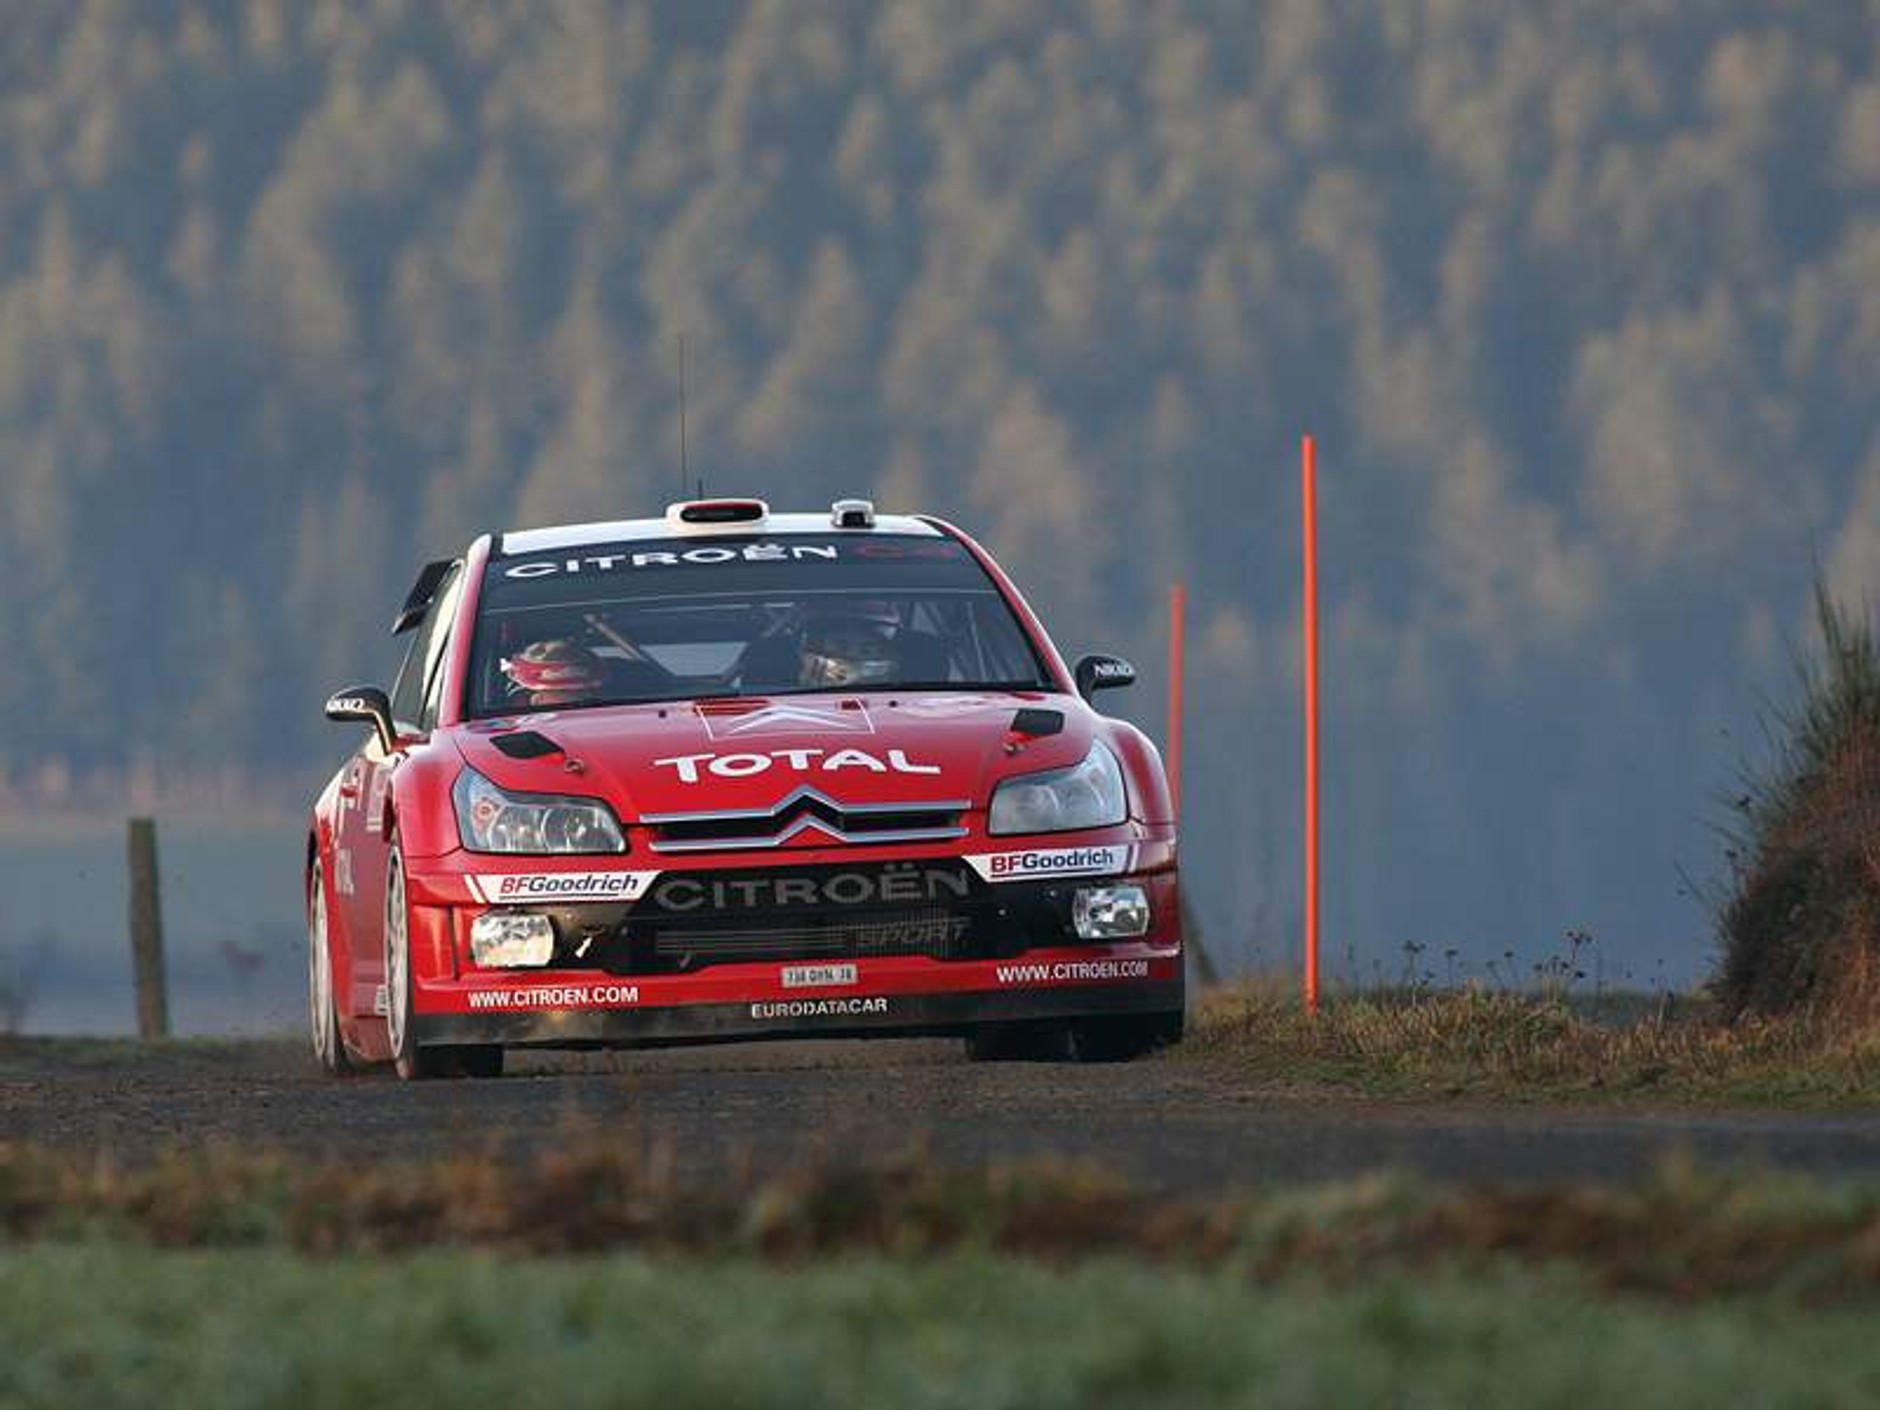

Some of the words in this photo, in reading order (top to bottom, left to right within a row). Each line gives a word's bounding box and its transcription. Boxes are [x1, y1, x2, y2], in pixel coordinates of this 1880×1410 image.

[504, 543, 837, 578] CITROËN
[653, 749, 941, 783] TOTAL
[985, 849, 1113, 873] BFGoodrich
[500, 874, 638, 894] BFGoodrich
[654, 863, 969, 911] CITROËN
[996, 960, 1148, 983] WWW.CITROEN.COM
[467, 986, 638, 1007] WWW.CITROEN.COM
[751, 997, 887, 1018] EURODATACAR
